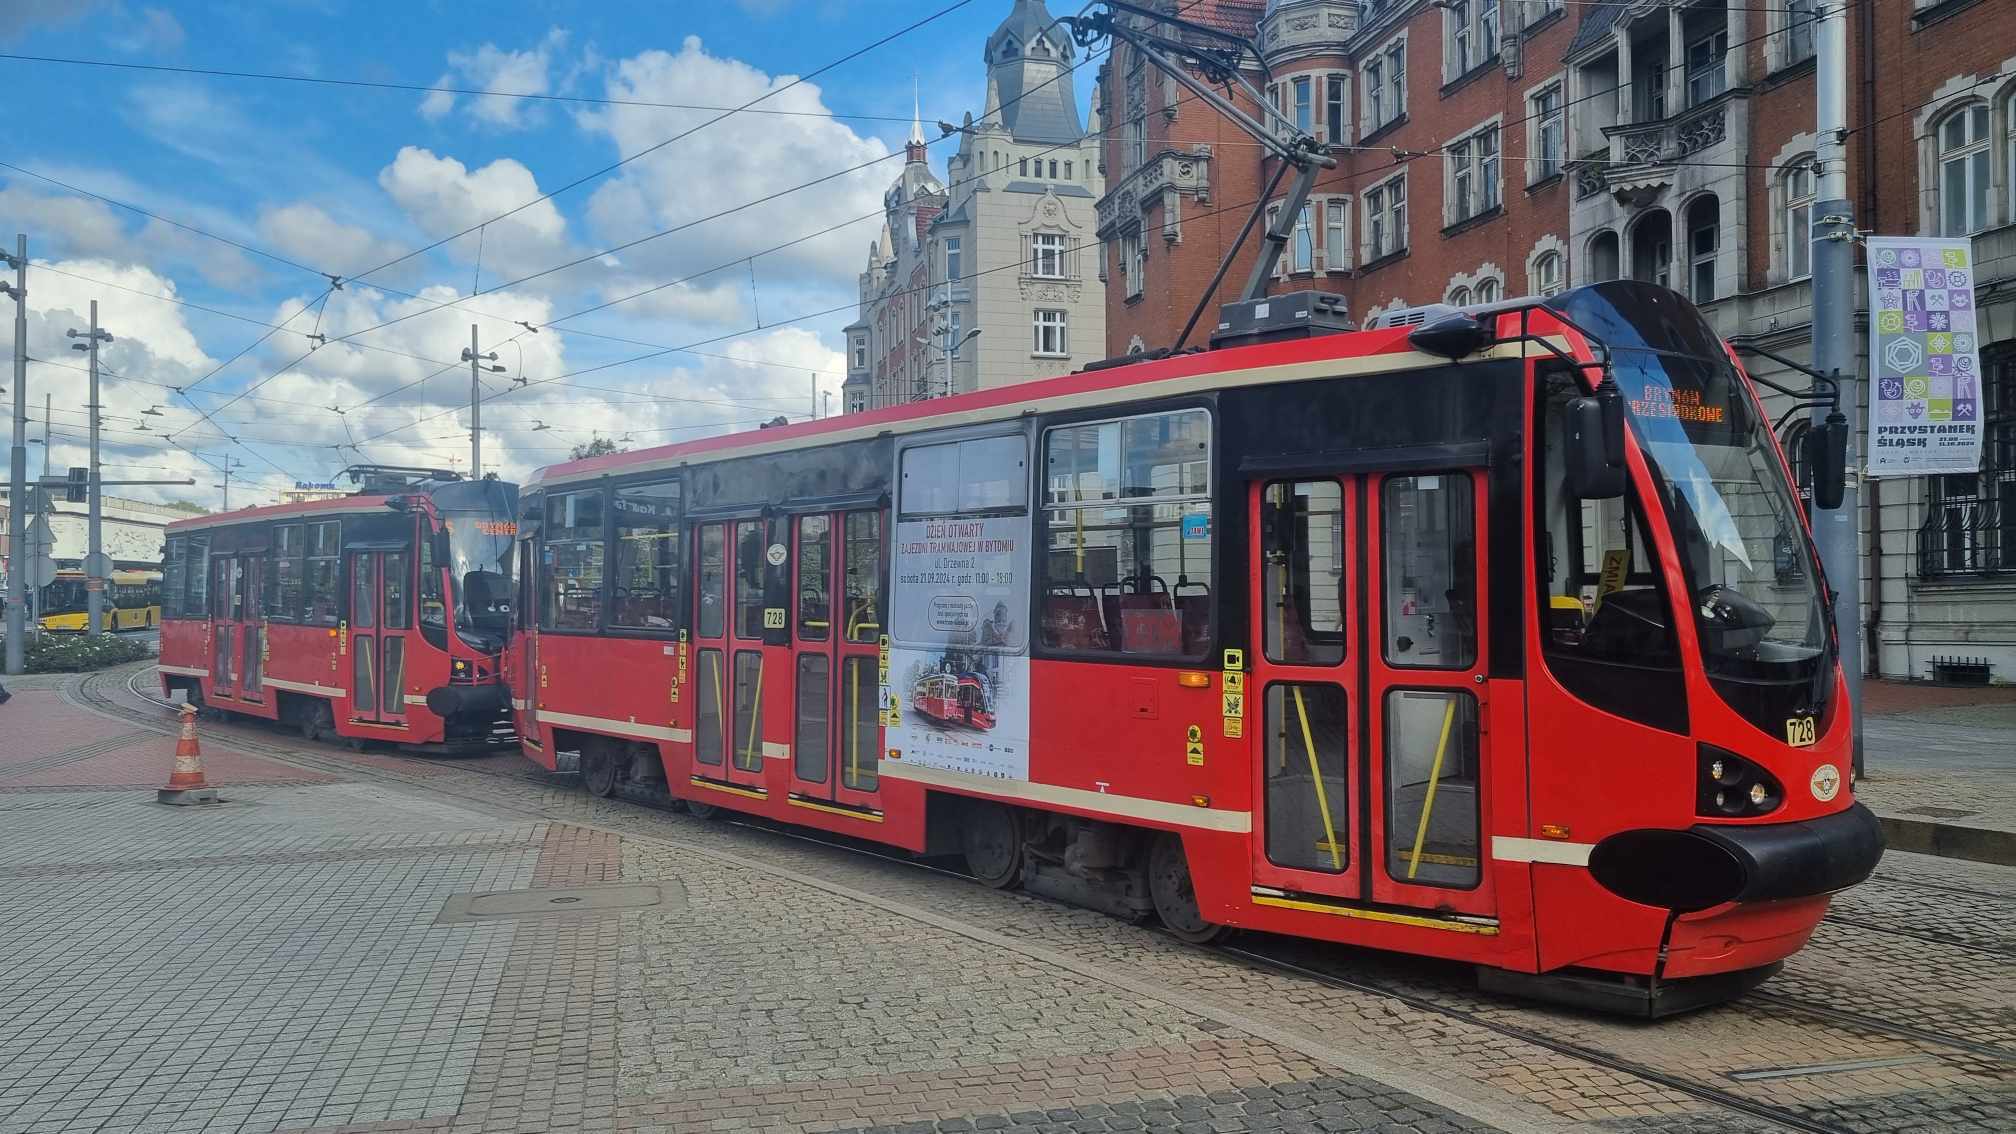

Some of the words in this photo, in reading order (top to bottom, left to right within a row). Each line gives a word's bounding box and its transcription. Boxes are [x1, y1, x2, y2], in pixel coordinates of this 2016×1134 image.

[1877, 424, 1976, 435] PRZYSTANEK
[1877, 436, 1928, 449] ŚLĄSK
[948, 522, 985, 538] OTWARTY
[929, 540, 976, 554] TRAMWAJOWEJ
[977, 541, 984, 553] W
[985, 539, 1014, 553] BYTOMIU
[919, 572, 950, 584] 21.09.2024
[767, 612, 783, 625] 728
[1789, 719, 1813, 744] 728
